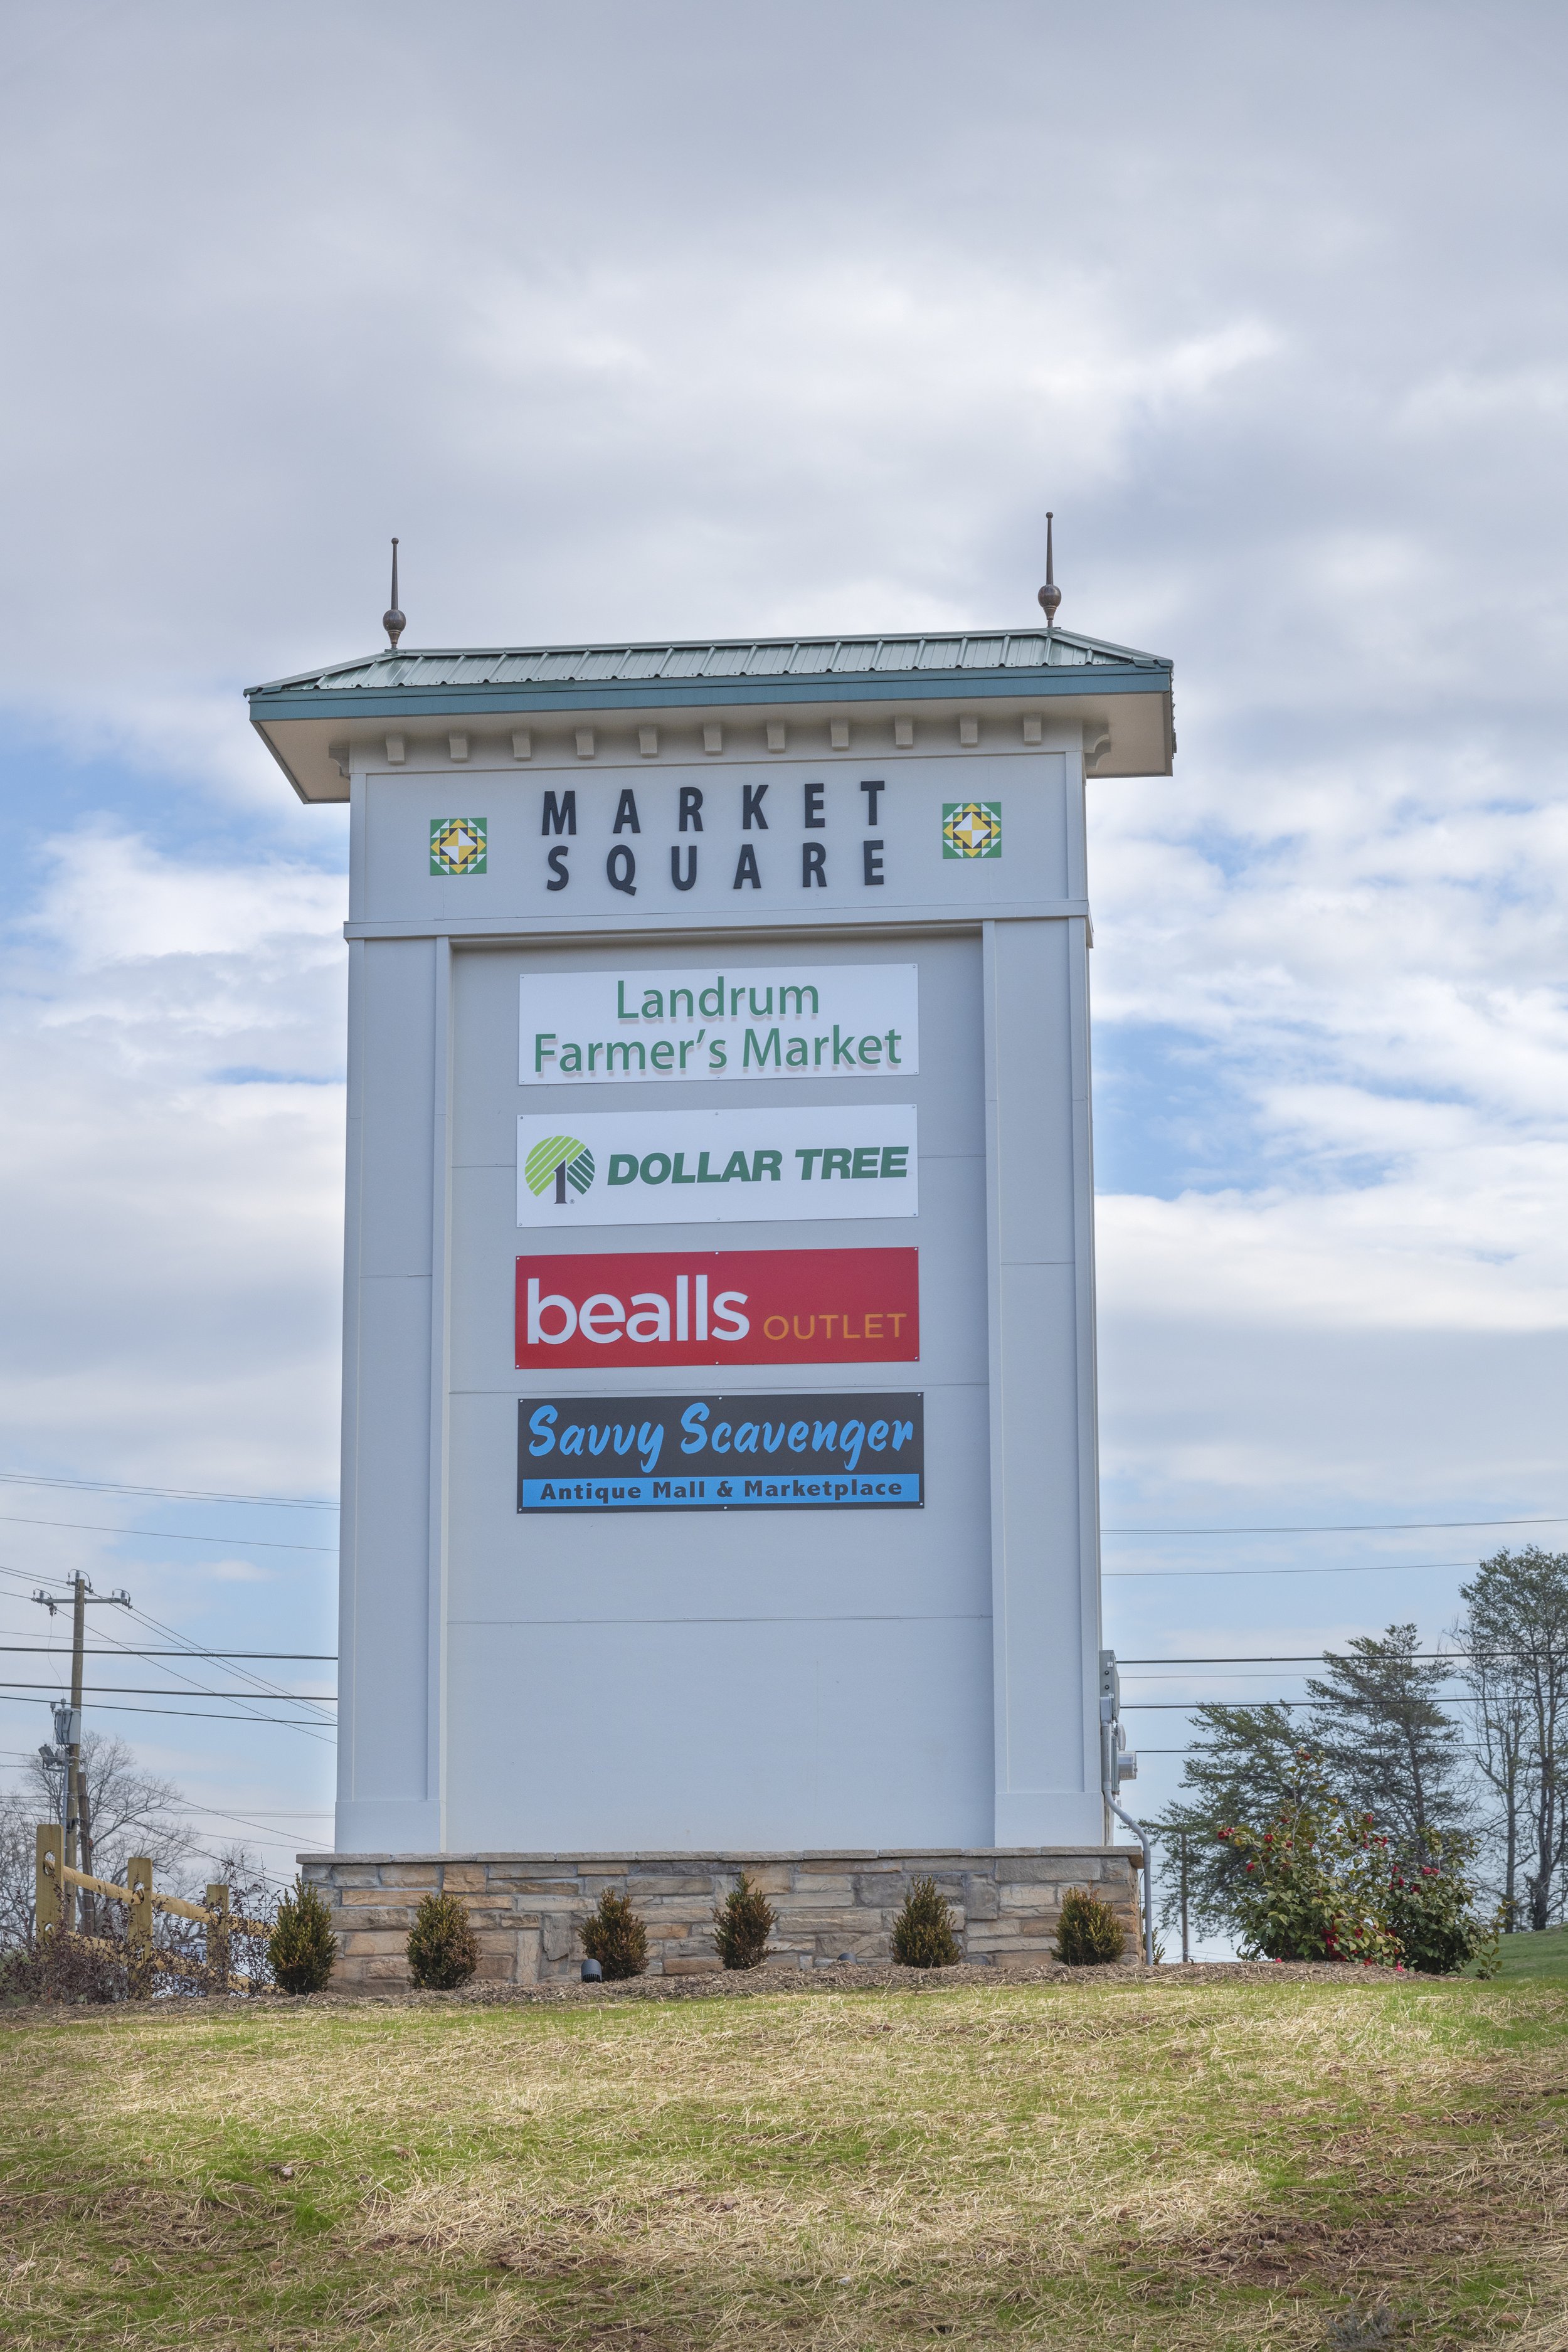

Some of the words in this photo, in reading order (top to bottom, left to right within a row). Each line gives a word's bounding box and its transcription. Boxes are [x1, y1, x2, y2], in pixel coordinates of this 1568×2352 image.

[541, 780, 886, 835] MARKET
[546, 839, 884, 896] SQUARE
[617, 977, 818, 1019] Landrum
[534, 1029, 728, 1073] Farmer's
[743, 1025, 902, 1067] Market
[607, 1150, 782, 1186] DOLLAR
[795, 1146, 909, 1180] TREE
[527, 1274, 750, 1344] bealls
[763, 1313, 907, 1340] OUTLET
[529, 1405, 664, 1473] Savvy
[681, 1402, 913, 1471] Scavenger
[540, 1483, 642, 1504] Antique
[653, 1481, 705, 1498] Mall
[716, 1481, 733, 1497] &
[744, 1479, 903, 1500] Marketplace
